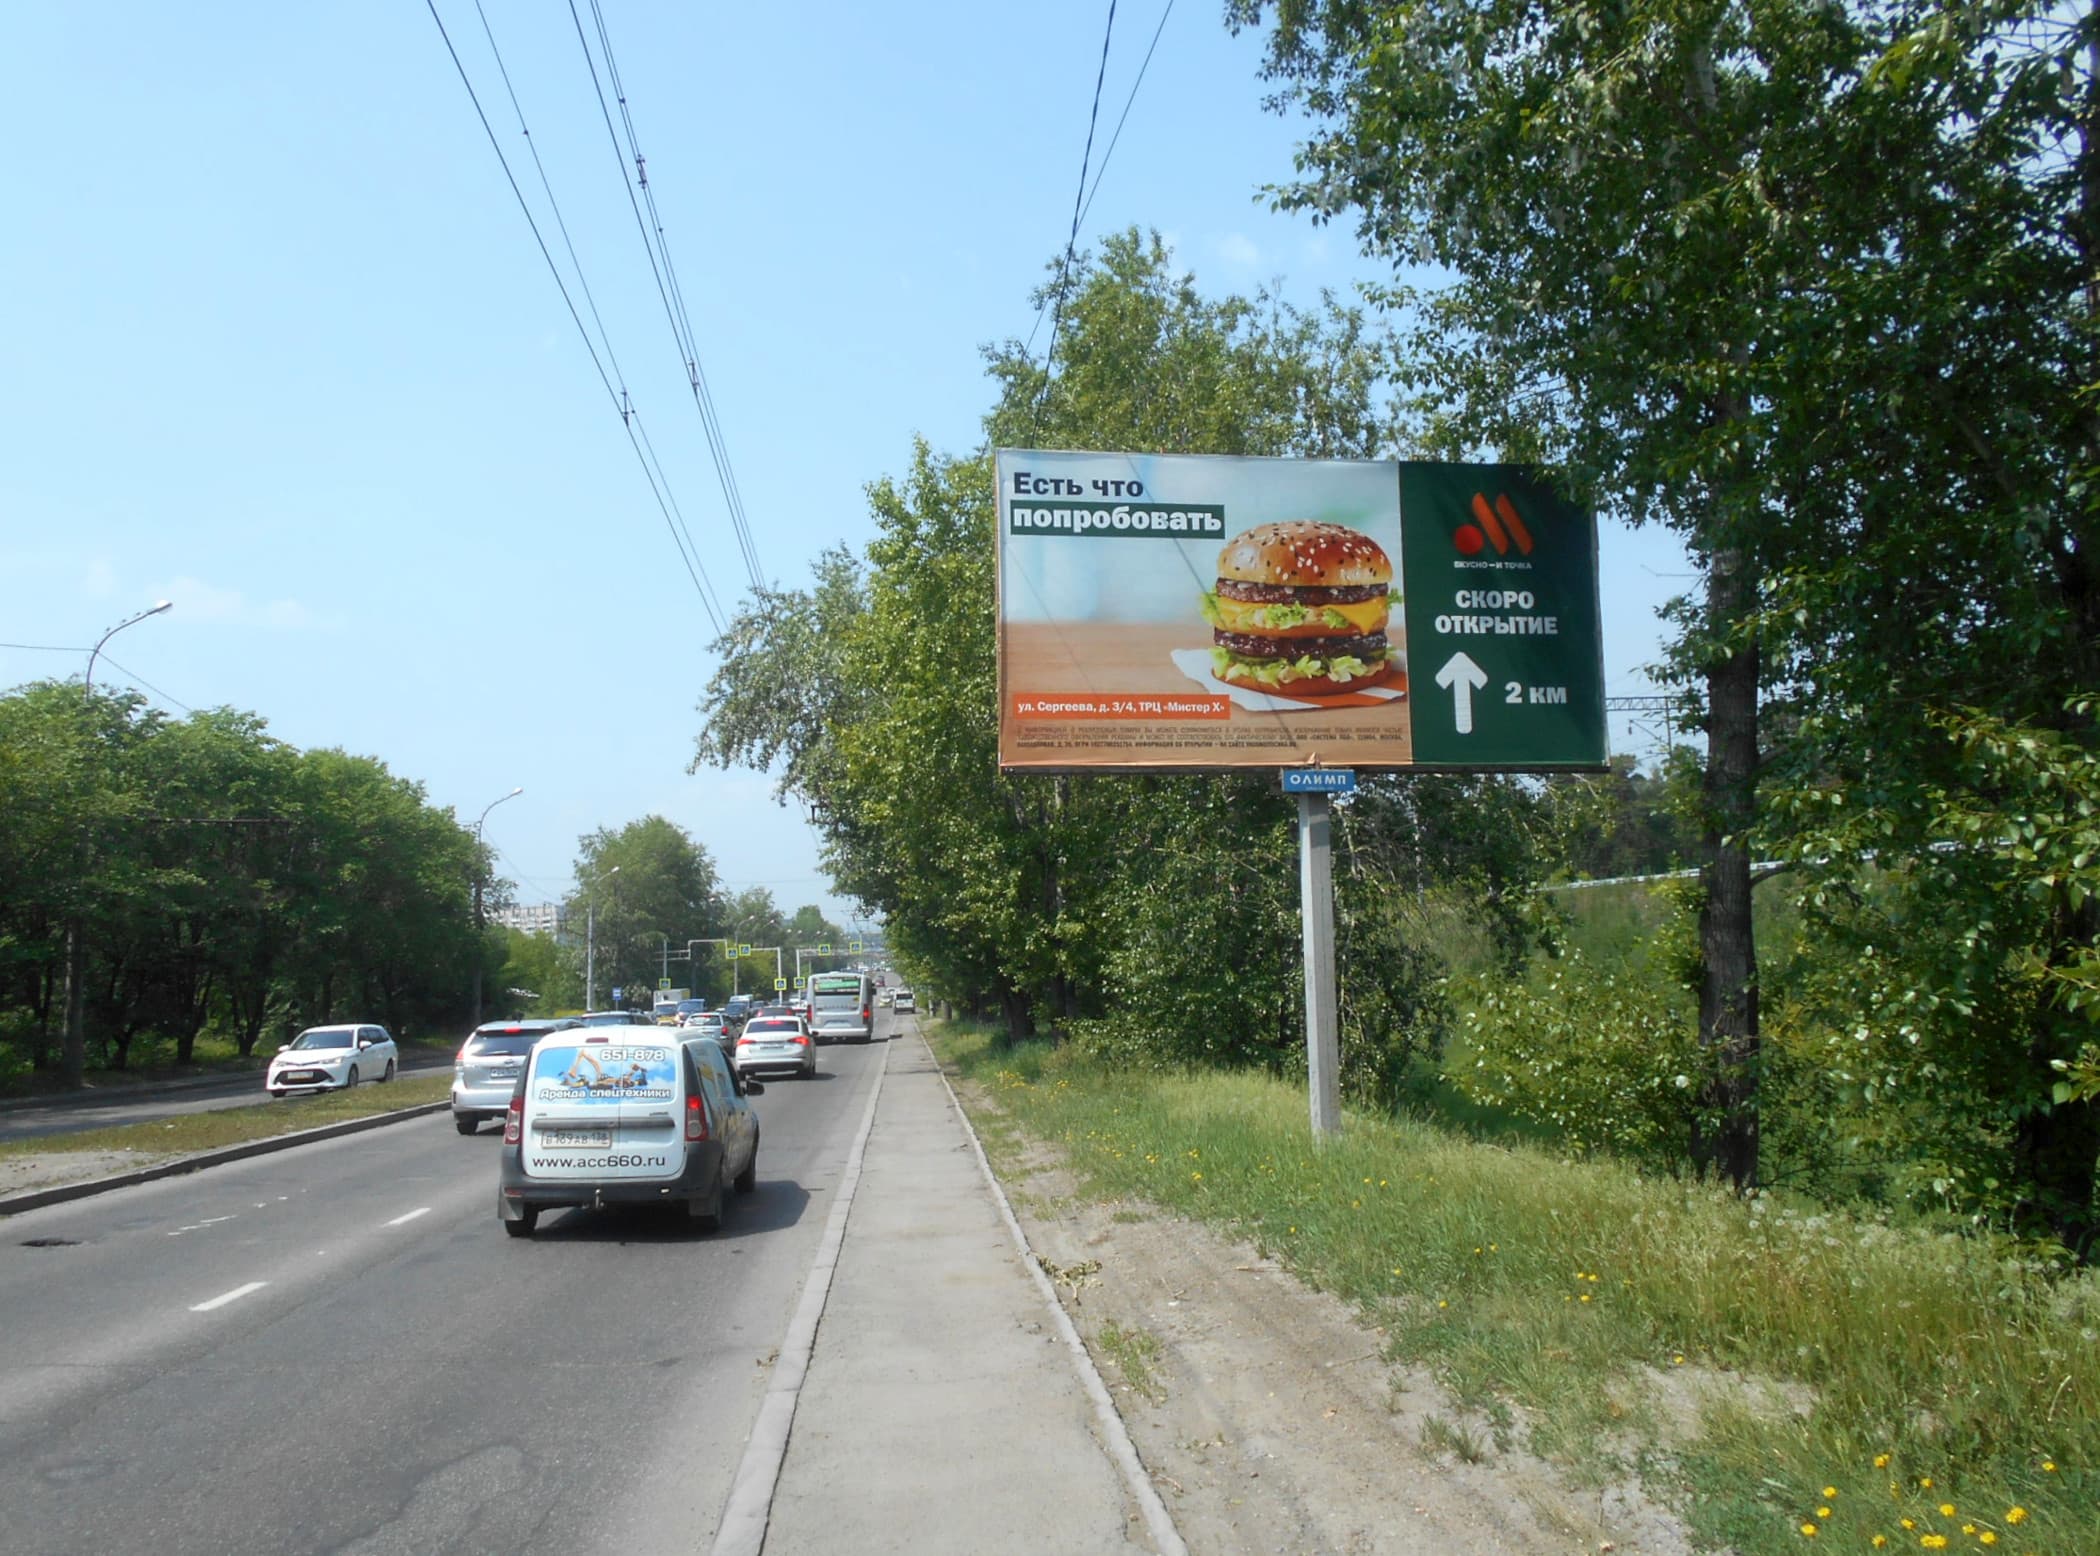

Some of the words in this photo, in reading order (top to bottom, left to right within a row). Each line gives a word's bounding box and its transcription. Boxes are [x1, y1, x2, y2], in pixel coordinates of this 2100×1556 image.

[1014, 472, 1083, 496] Есть
[1092, 480, 1144, 497] что
[1013, 505, 1223, 533] попробовать
[1455, 590, 1534, 609] СКОРО
[1435, 615, 1558, 634] ОТКРЫТИЕ
[1505, 681, 1523, 704] 2
[1018, 702, 1035, 712] ул.
[1037, 701, 1096, 713] Сергеева,
[1112, 701, 1136, 713] 3/4,
[1139, 702, 1162, 713] ТРЦ
[1290, 774, 1346, 784] ОЛИМП
[601, 1049, 666, 1062] 651-878
[539, 1089, 586, 1100] Аренда
[589, 1088, 672, 1099] спецтехники
[532, 1154, 666, 1168] www.acc660.ru
